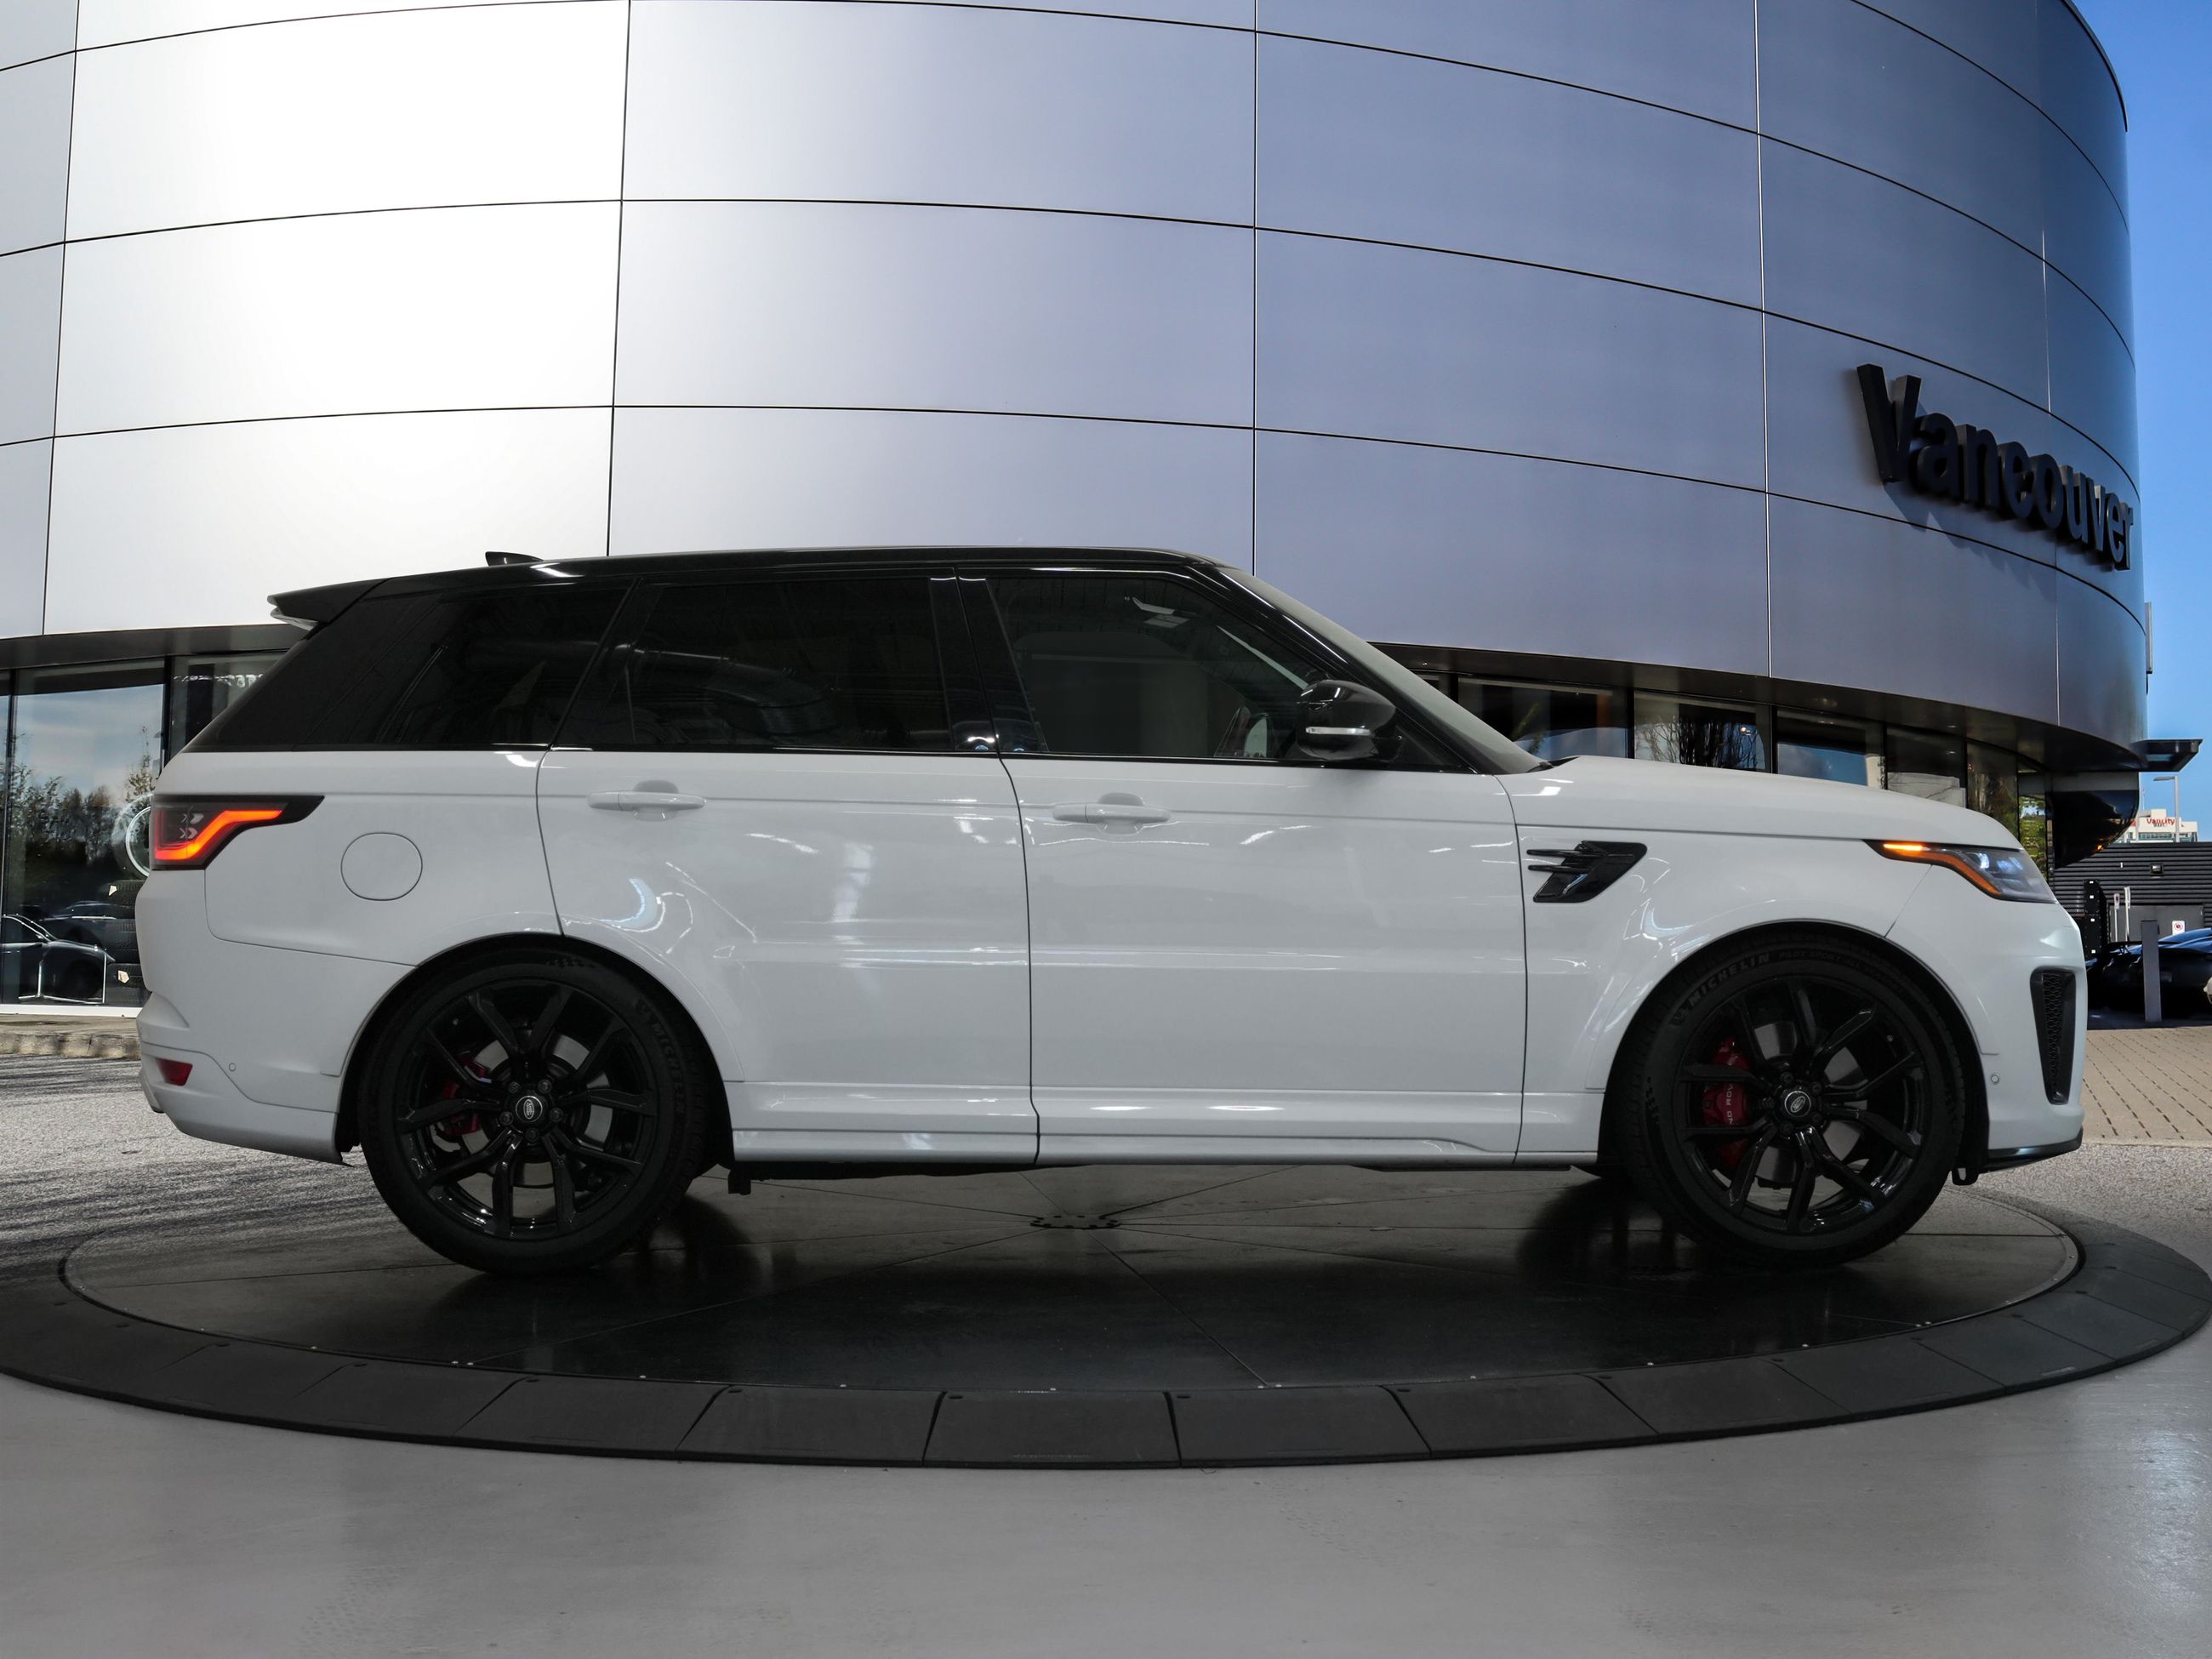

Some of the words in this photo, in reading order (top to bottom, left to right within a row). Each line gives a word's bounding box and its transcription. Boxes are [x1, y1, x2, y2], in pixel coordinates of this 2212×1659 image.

[1857, 363, 2134, 570] Vancouver
[2146, 817, 2175, 826] Vancity
[1689, 952, 1770, 1007] MICHELIN
[652, 1022, 686, 1114] MICHELIN
[1725, 1083, 1734, 1106] ROV
